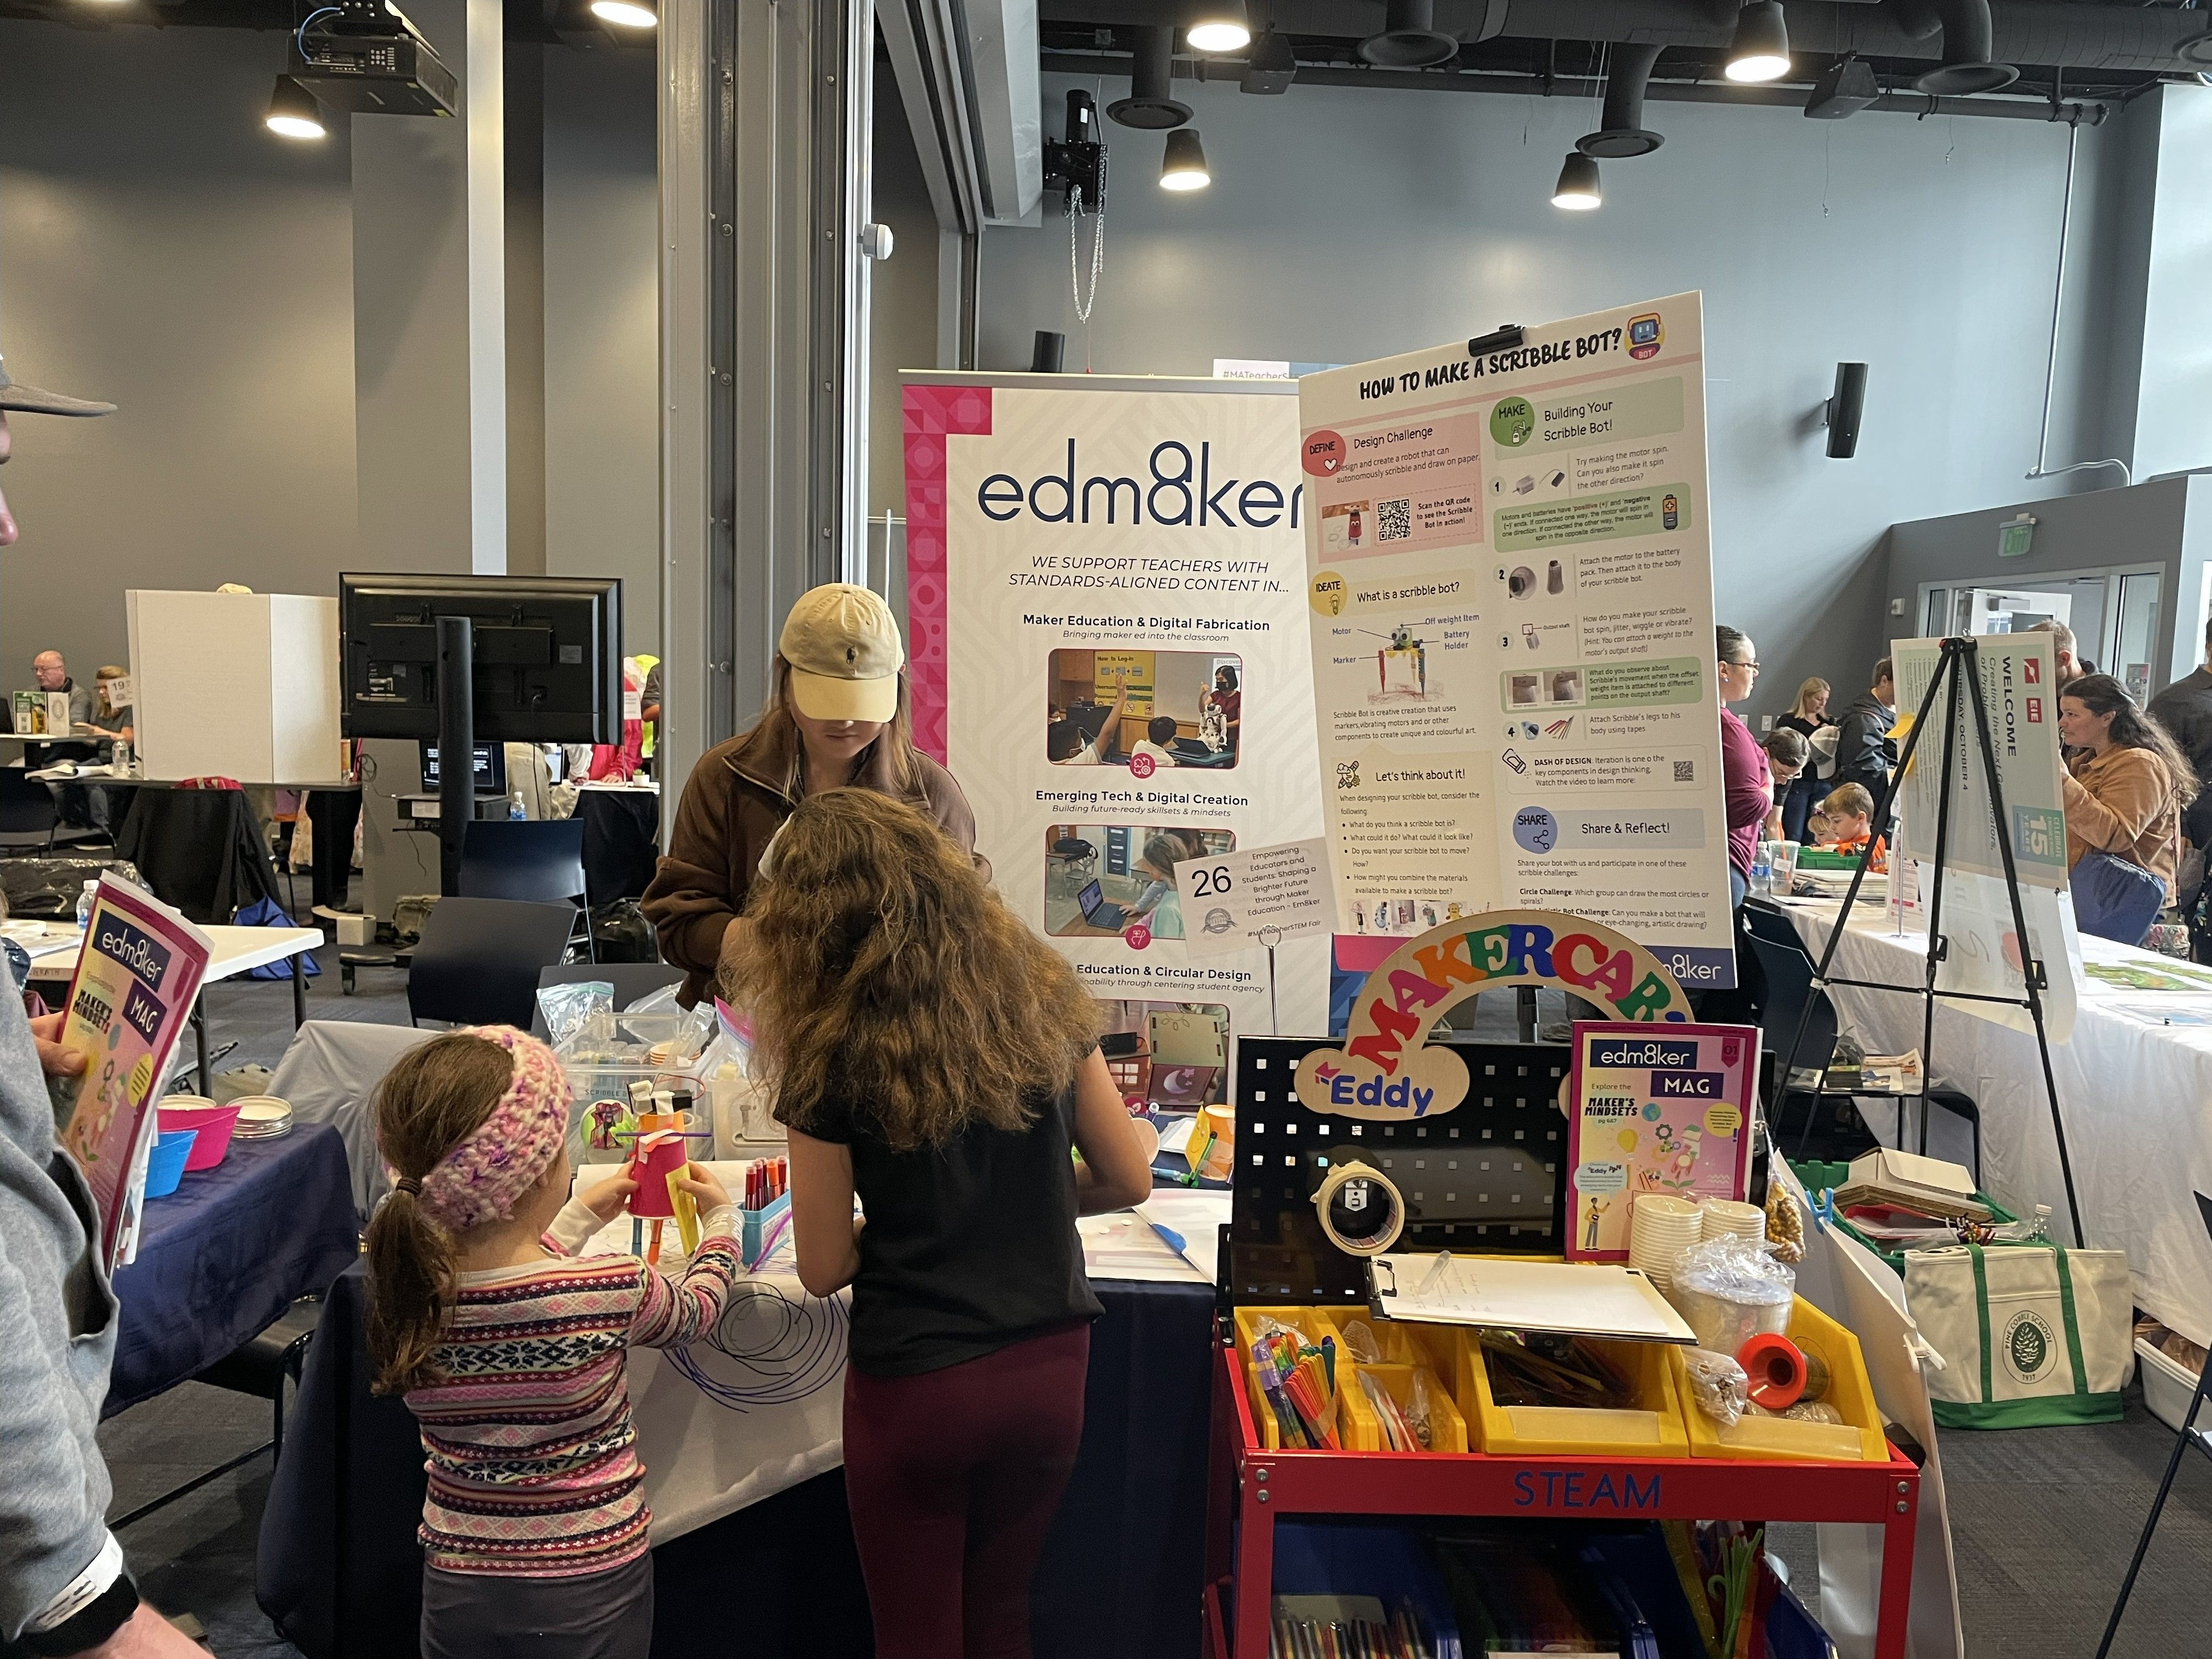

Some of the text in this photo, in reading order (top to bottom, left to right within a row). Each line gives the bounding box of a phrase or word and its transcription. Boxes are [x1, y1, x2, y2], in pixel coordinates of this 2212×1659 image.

[1639, 349, 1651, 359] BOT
[1360, 331, 1622, 399] HOW TO MAKE A SCRIBBLE BOT?
[1499, 404, 1525, 419] MAKE
[1544, 402, 1612, 421] Building Your
[1544, 419, 1612, 441] Scribble Bot!
[1354, 428, 1432, 449] Design Challenge
[1310, 442, 1335, 454] DEFINE
[1494, 481, 1500, 492] 1
[1447, 506, 1472, 515] Scribble
[1444, 517, 1465, 526] action!
[1032, 556, 1268, 573] WE SUPPORT TEACHERS WITH
[1499, 569, 1505, 580] 2
[1008, 574, 1288, 592] STANDARDS-ALIGNED CONTENT IN...
[1316, 580, 1341, 592] IDEATE
[1357, 591, 1381, 602] What
[1383, 590, 1390, 600] is
[1400, 585, 1436, 597] scribble
[1438, 582, 1459, 593] bot?
[1024, 614, 1269, 630] Maker Education & Digital Fabrication
[1437, 615, 1462, 624] weight
[1063, 630, 1101, 640] Bringing
[1444, 641, 1468, 650] Holder
[1503, 637, 1508, 647] 3
[1980, 657, 1987, 670] of
[113, 681, 125, 691] 19
[2002, 656, 2016, 757] WELCOME
[1508, 727, 1515, 737] 4
[1959, 725, 1967, 781] OCTOBER
[1375, 768, 1465, 781] Let's think about it!
[1036, 790, 1248, 805] Emerging Tech & Digital Creation
[1052, 805, 1088, 813] Building
[1091, 805, 1146, 814] future-ready
[1517, 815, 1547, 825] SHARE
[1582, 822, 1669, 833] Share & Reflect!
[2030, 816, 2048, 855] 15
[1252, 847, 1299, 860] Empowering
[1250, 856, 1304, 871] Educators and
[1191, 866, 1232, 898] 26
[1242, 873, 1276, 883] Students:
[1278, 868, 1309, 877] Shaping
[1253, 879, 1308, 893] Brighter Future
[1255, 893, 1285, 903] through
[1248, 905, 1285, 916] Education
[1077, 964, 1250, 982] Education & Circular Design
[1084, 978, 1116, 986] nability
[1118, 979, 1152, 988] through
[1154, 982, 1194, 990] centering
[1349, 924, 1685, 1076] MAKERCAR
[131, 994, 157, 1032] MAG
[1664, 1077, 1710, 1094] MAG
[1329, 1075, 1434, 1116] Eddy
[1588, 1098, 1635, 1107] MAKER'S
[1584, 1107, 1638, 1116] MINDSETS
[2030, 1315, 2053, 1344] SCHOOL
[1513, 1472, 1661, 1509] STEAM
